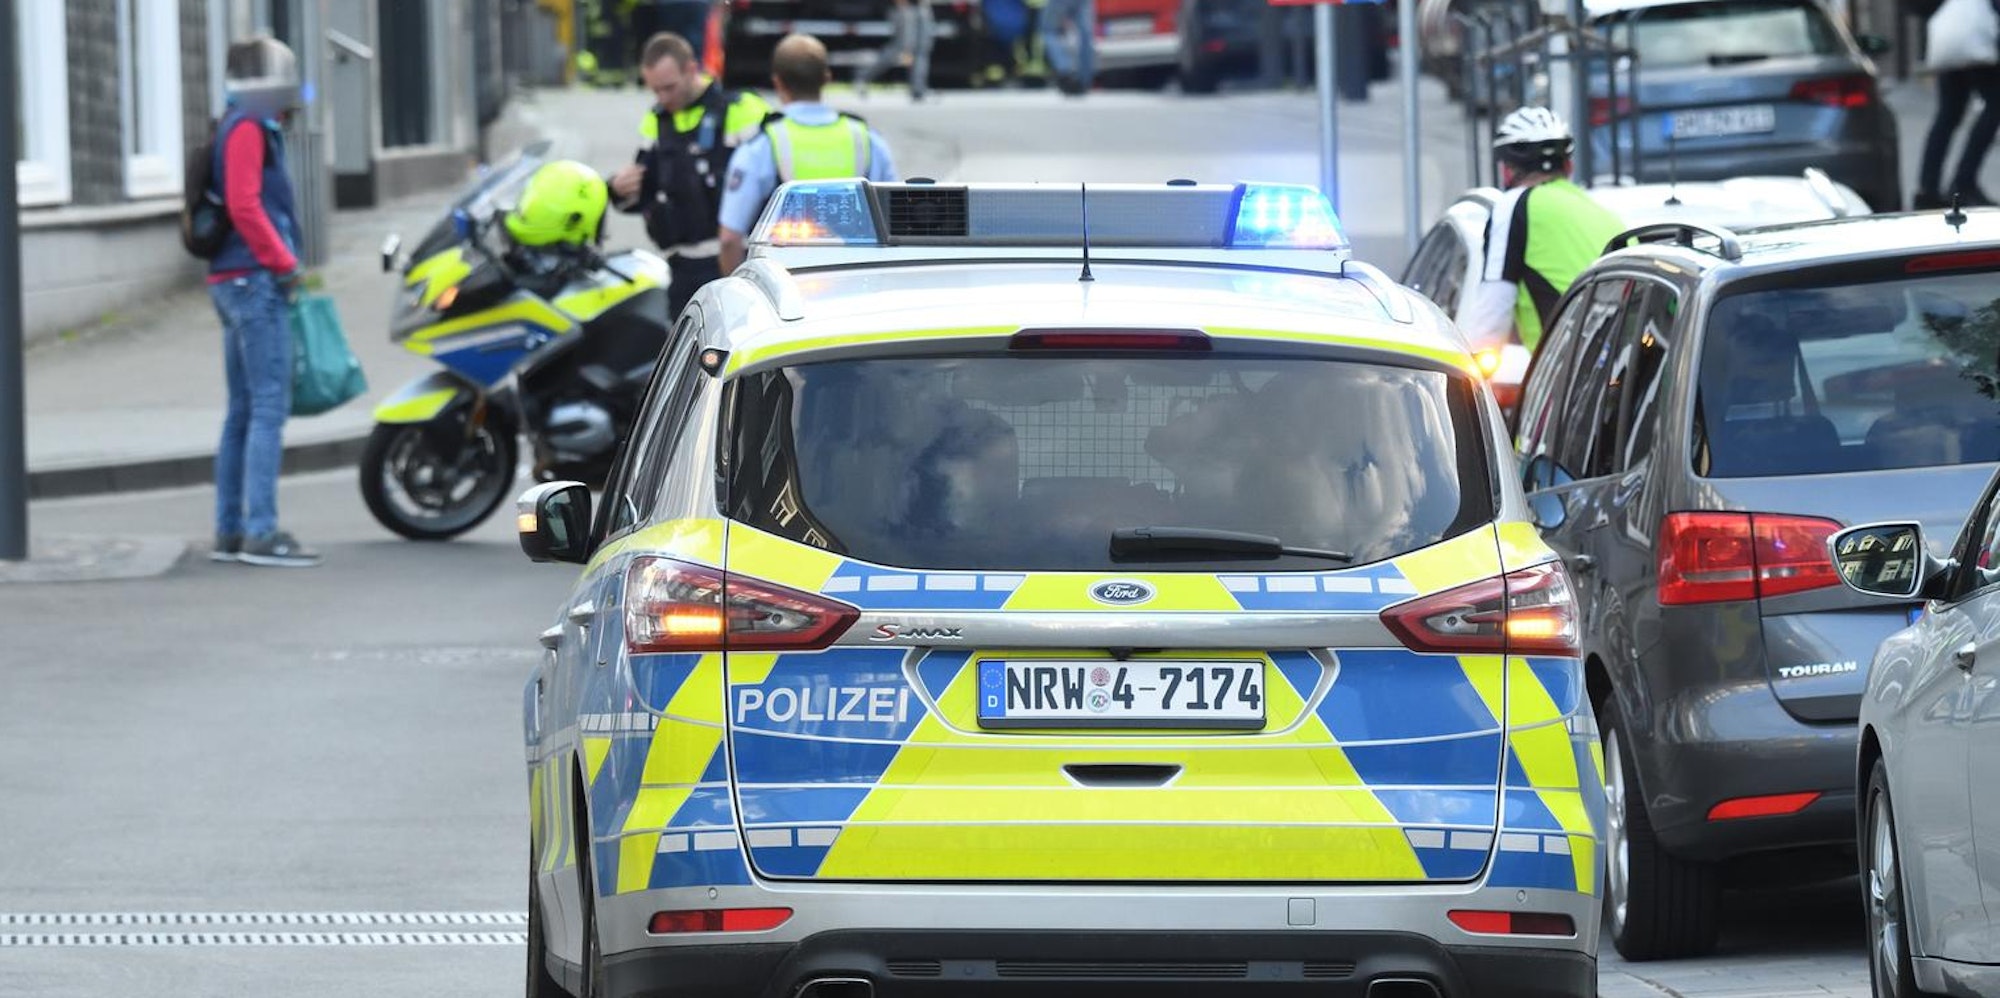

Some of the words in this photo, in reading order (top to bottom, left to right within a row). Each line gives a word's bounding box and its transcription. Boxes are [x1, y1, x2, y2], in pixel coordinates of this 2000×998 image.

[1104, 584, 1139, 598] Ford
[1779, 661, 1857, 678] TOURAN
[1007, 667, 1085, 710] NRW
[736, 687, 909, 723] POLIZEI
[987, 695, 998, 708] D
